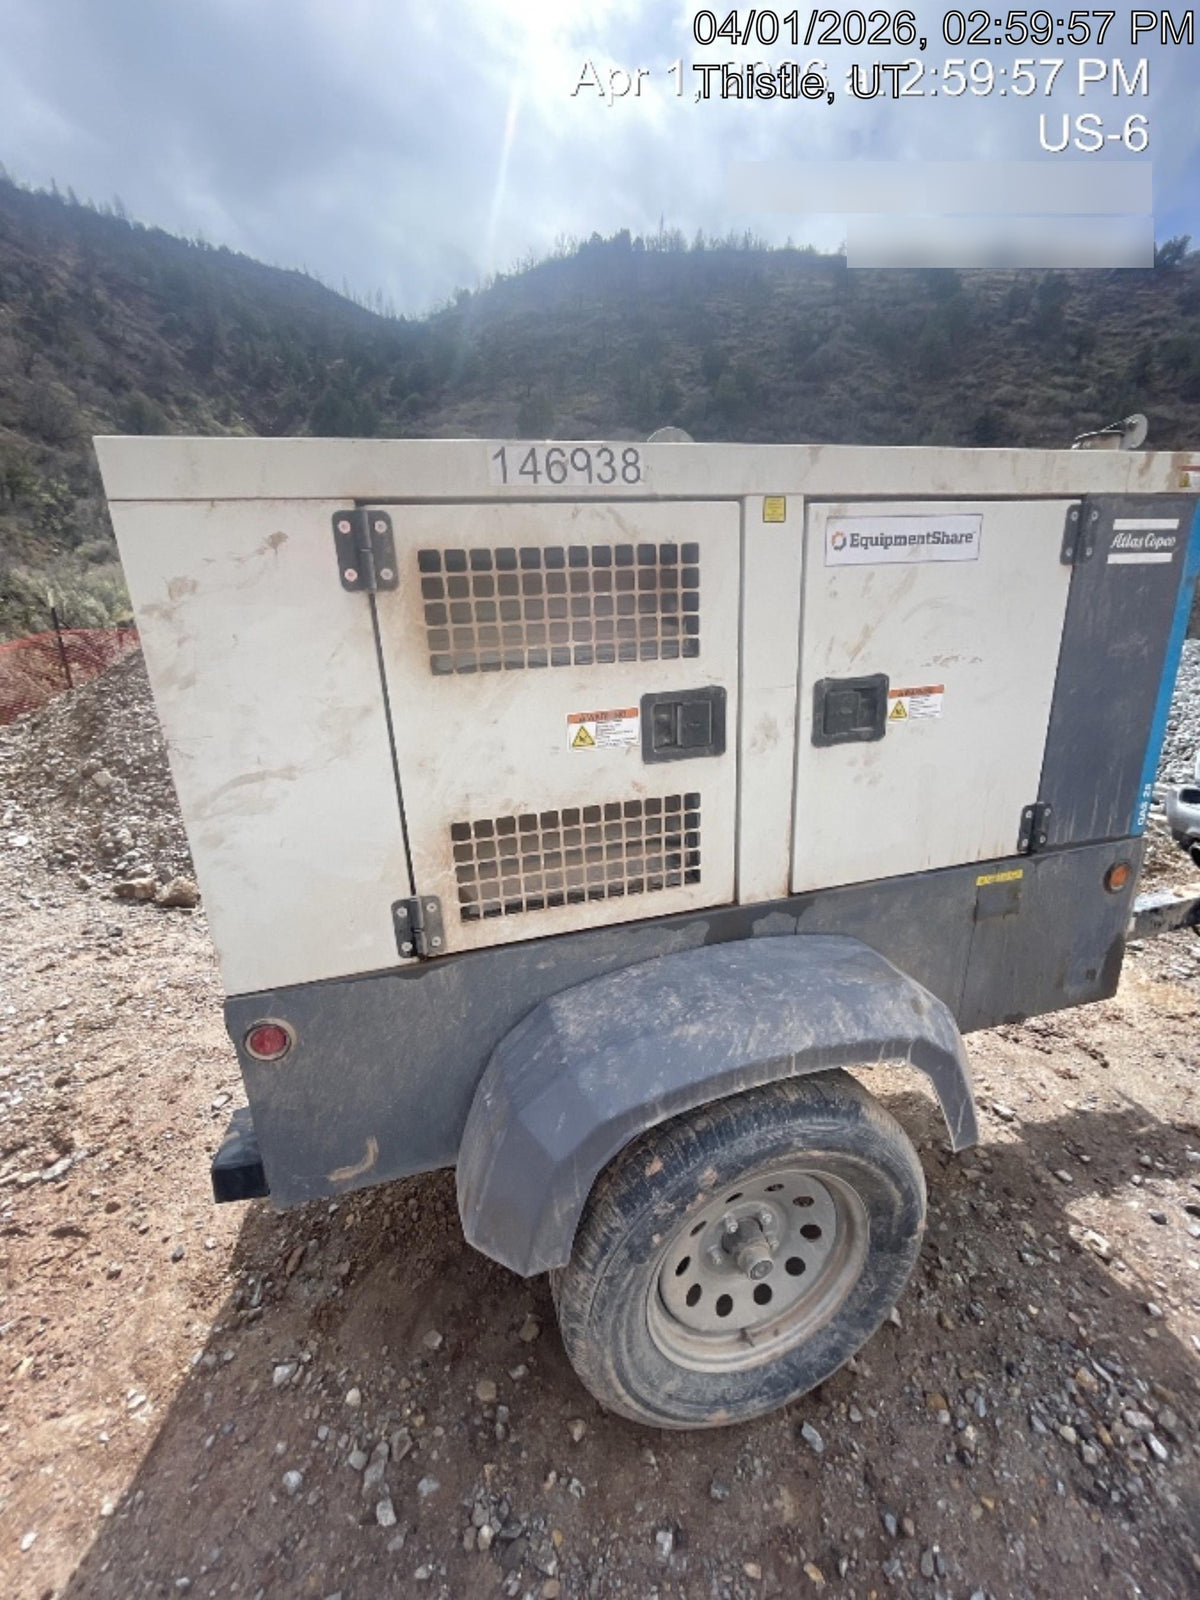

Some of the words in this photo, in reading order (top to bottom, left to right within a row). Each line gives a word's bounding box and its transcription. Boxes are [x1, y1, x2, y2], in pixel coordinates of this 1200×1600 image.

[492, 446, 641, 484] 146938
[849, 531, 974, 550] EquipmentShare
[1110, 533, 1143, 548] Atlas
[1144, 533, 1176, 549] Copco
